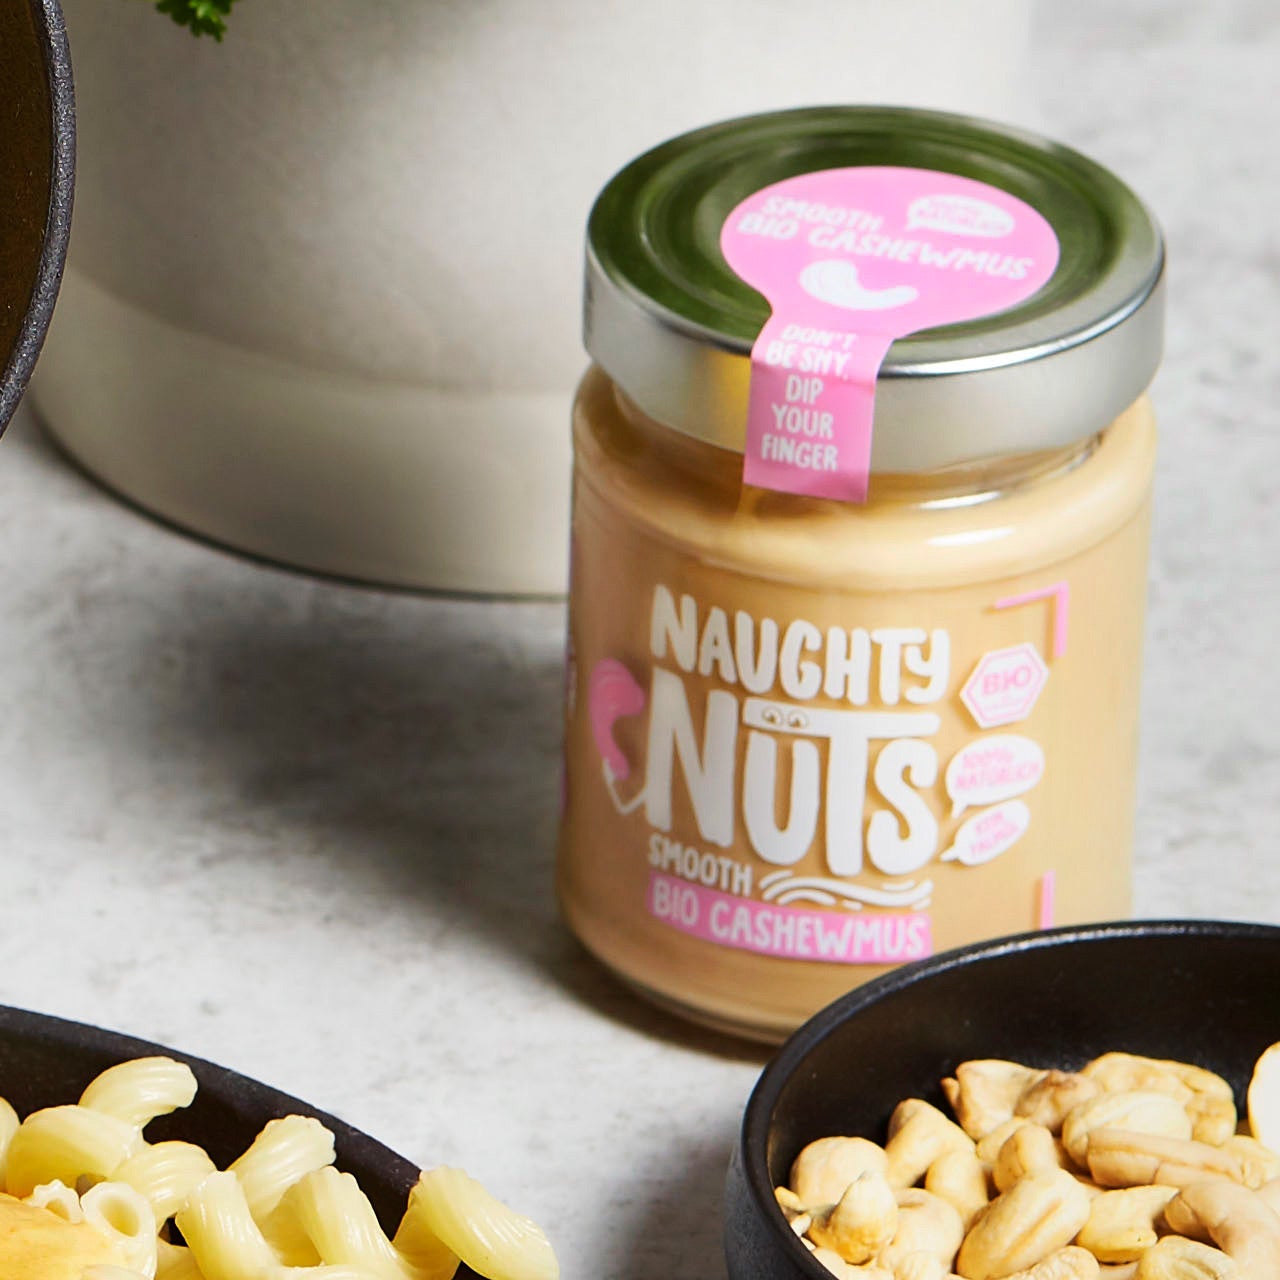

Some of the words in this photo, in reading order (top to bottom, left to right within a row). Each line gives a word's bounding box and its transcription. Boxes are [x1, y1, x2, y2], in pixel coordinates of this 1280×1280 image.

[761, 196, 884, 231] SMOOTH
[736, 211, 799, 240] BIO
[807, 225, 1035, 280] CASHEWMUS
[765, 341, 801, 368] BE
[780, 324, 856, 348] DON'T
[785, 374, 823, 405] DIP
[771, 404, 834, 440] YOUR
[761, 433, 838, 472] FINGER
[649, 584, 950, 705] NAUGHTY
[982, 665, 1032, 696] BIO
[645, 666, 940, 877] NUTS
[648, 832, 753, 897] SMOOTH
[652, 877, 699, 927] BIO
[709, 900, 928, 957] CASHEWMUS
